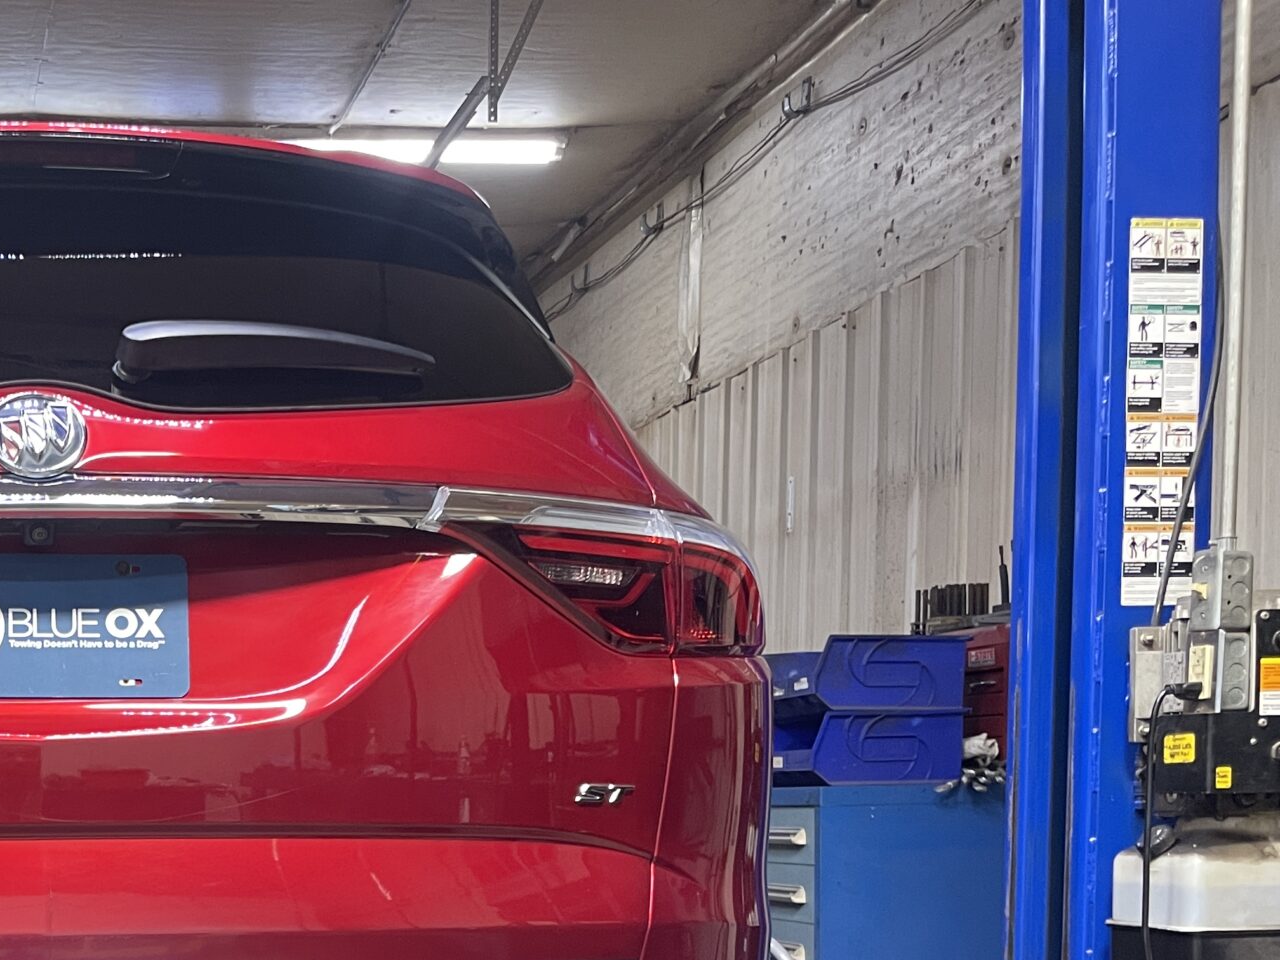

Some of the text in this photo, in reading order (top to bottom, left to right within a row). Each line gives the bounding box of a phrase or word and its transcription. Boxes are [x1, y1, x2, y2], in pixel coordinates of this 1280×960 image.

[7, 607, 166, 639] BLUE OX
[8, 639, 43, 650] Towing
[43, 639, 79, 649] Doesn't
[80, 639, 103, 649] Have
[104, 640, 115, 649] to
[115, 639, 128, 649] be
[574, 783, 637, 804] ST
